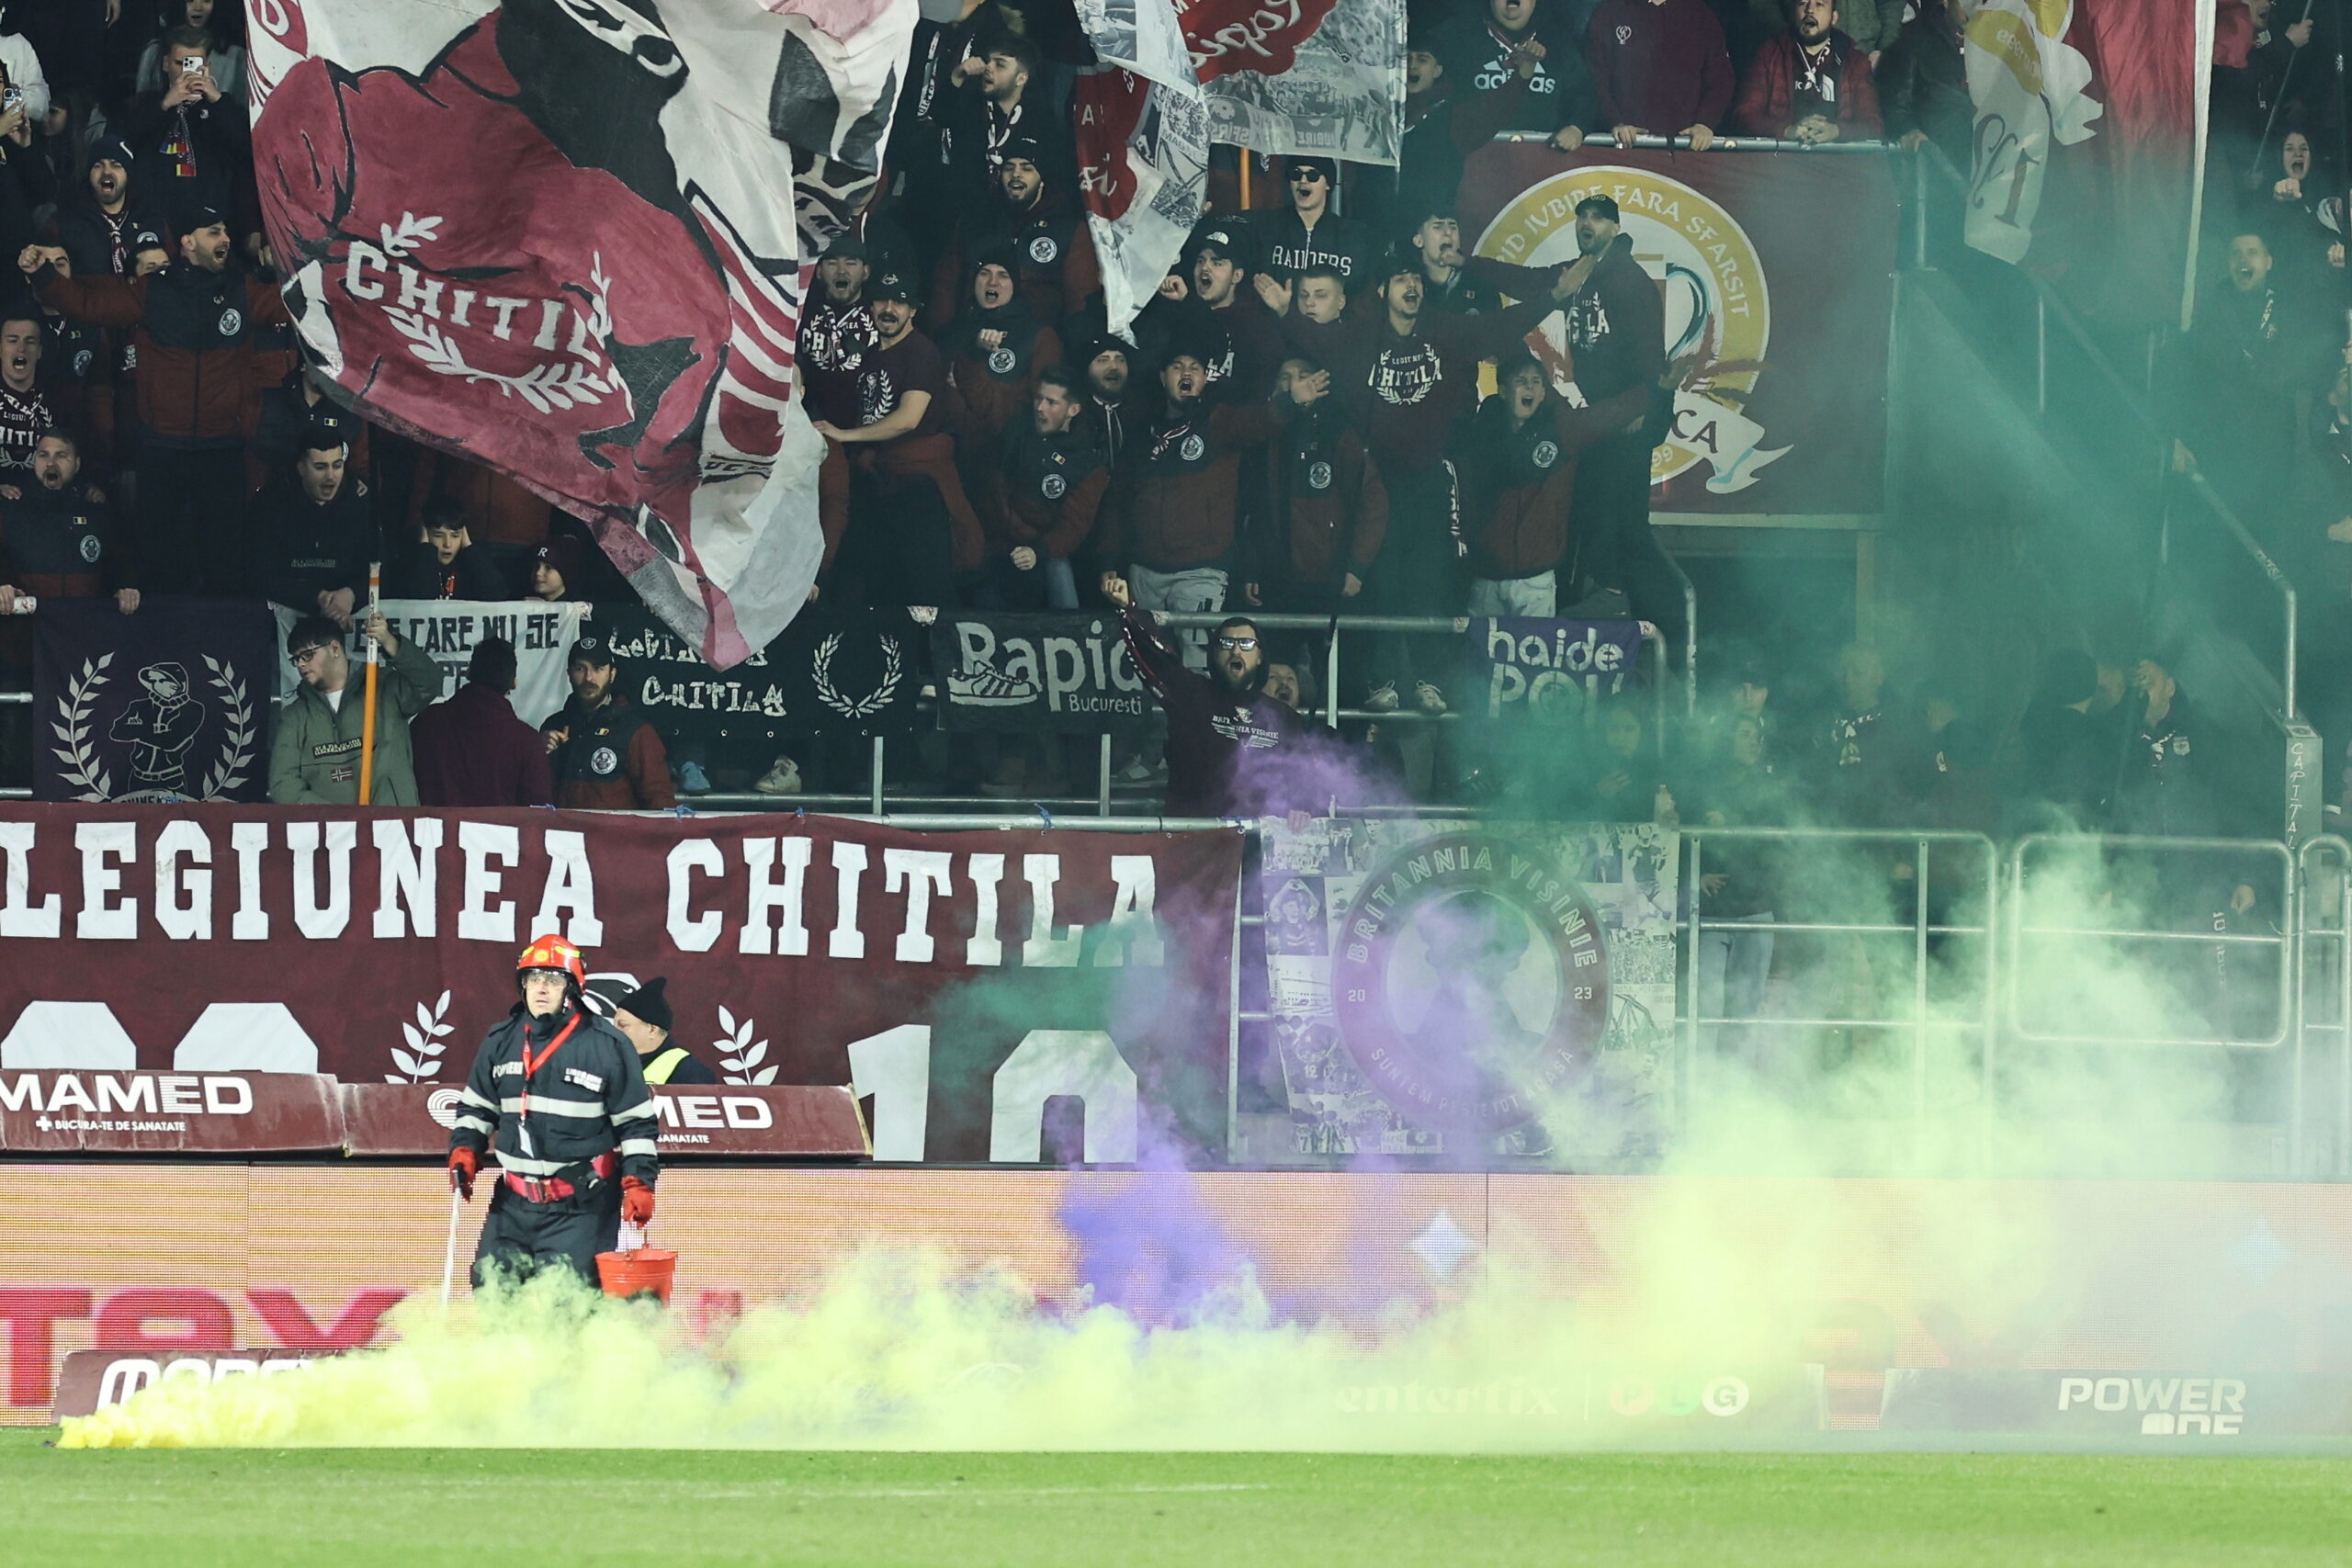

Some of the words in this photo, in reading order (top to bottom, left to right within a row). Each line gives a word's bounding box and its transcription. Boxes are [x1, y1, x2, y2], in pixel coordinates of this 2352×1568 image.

[1475, 69, 1555, 94] adas
[1613, 185, 1681, 222] FARA
[1687, 217, 1750, 318] SFARSIT
[526, 613, 560, 649] SE
[1487, 617, 1624, 671] haide
[1069, 694, 1142, 715] Bucuresti
[0, 818, 603, 947] LEGIUNEA
[666, 836, 1164, 967] CHITILA
[1347, 846, 1493, 963] BRITANNIA
[1348, 988, 1366, 1002] 20
[1574, 987, 1593, 1000] 23
[55, 1120, 114, 1132] BUCURA-TE
[115, 1121, 130, 1132] DE
[131, 1121, 187, 1133] SANATATE
[2058, 1377, 2247, 1413] POWER
